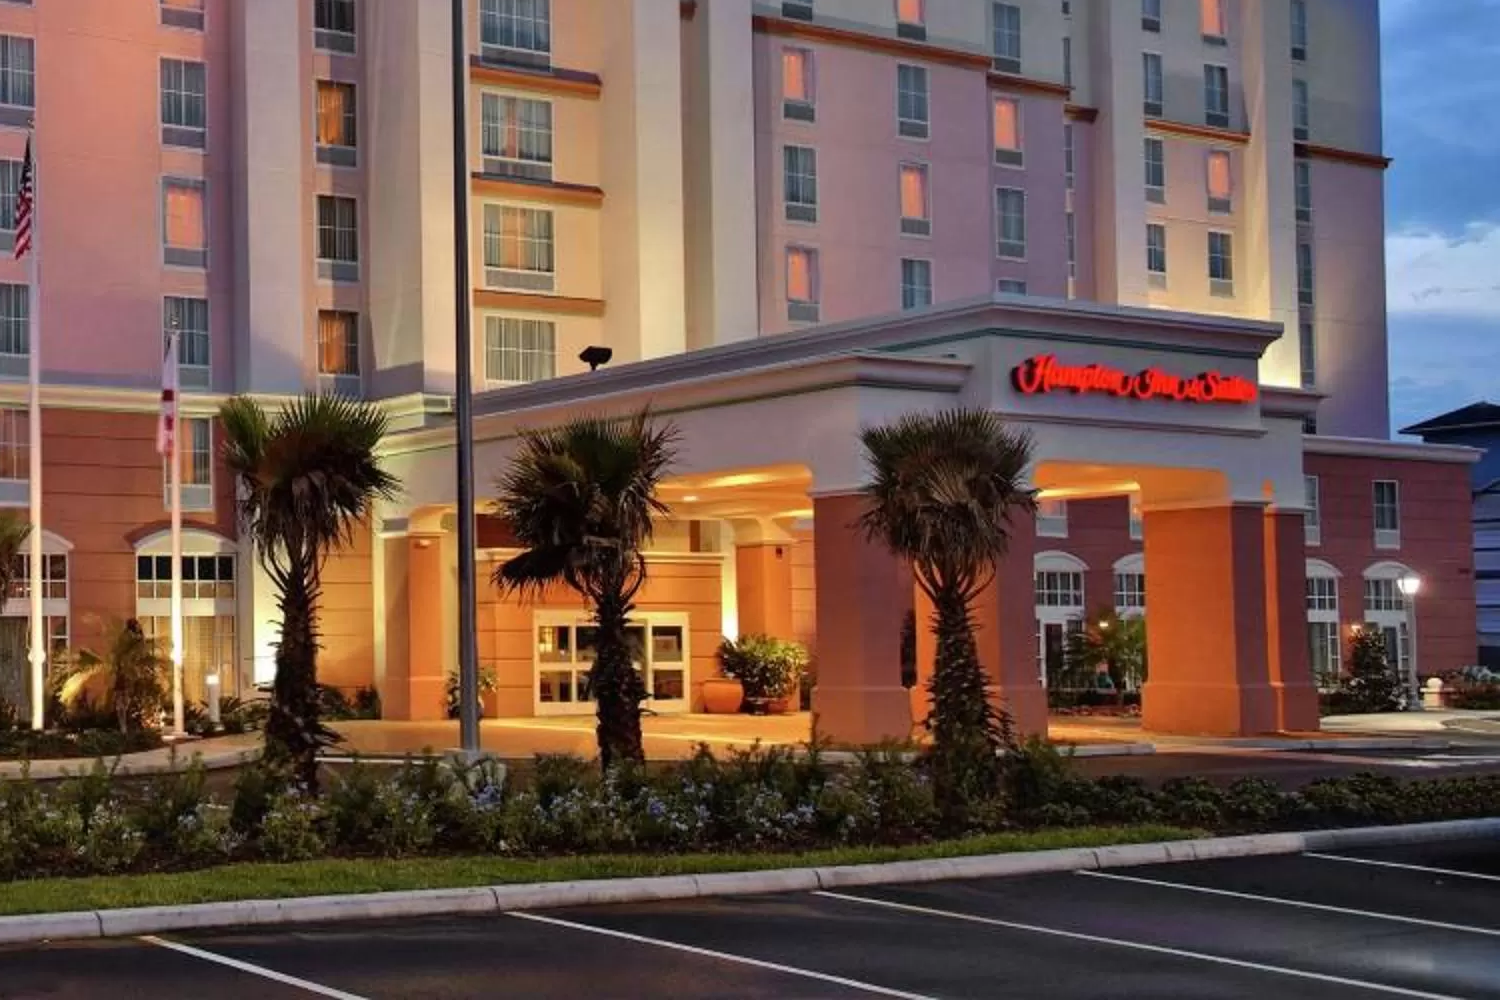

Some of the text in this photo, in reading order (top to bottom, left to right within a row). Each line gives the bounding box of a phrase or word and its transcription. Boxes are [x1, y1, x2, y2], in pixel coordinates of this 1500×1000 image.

[1017, 353, 1133, 396] Hampton
[1133, 366, 1186, 399] Inn
[1199, 369, 1257, 402] Suites
